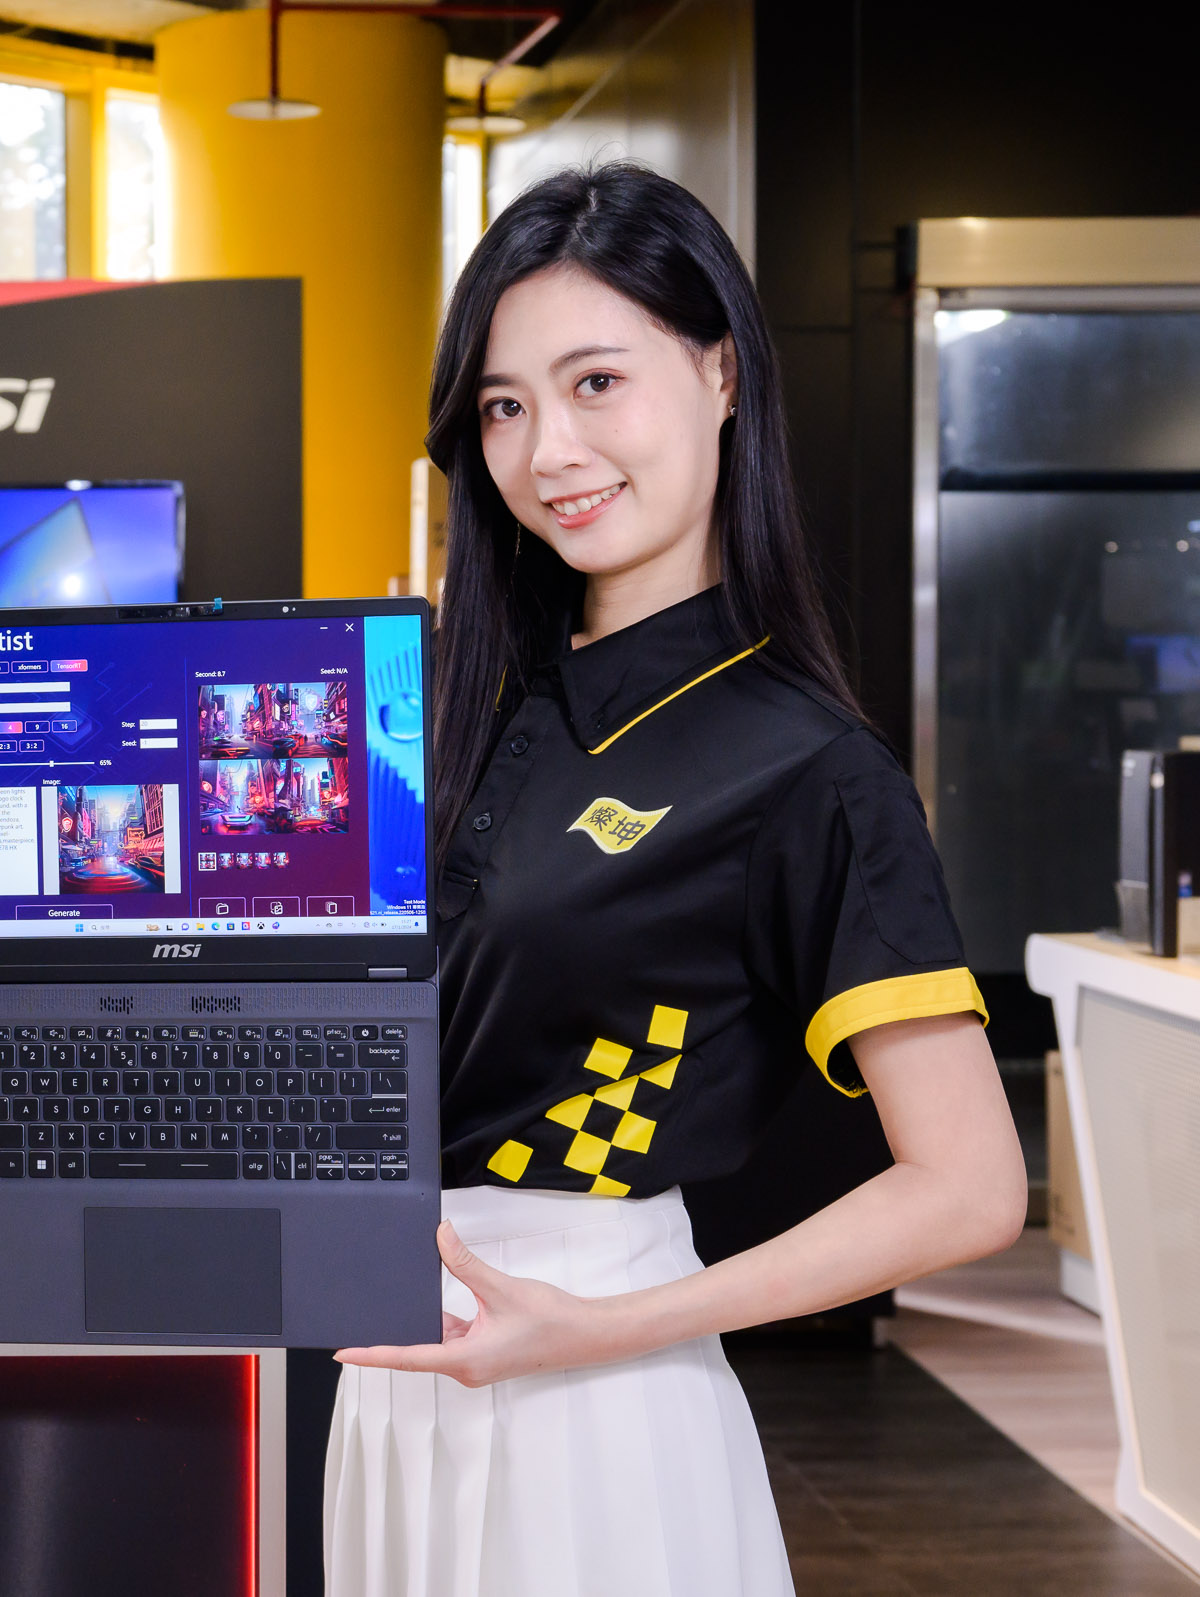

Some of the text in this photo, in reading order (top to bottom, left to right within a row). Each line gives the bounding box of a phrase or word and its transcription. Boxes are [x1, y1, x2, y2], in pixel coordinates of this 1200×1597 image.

[17, 663, 42, 671] xformers
[56, 662, 82, 670] TensorRT
[320, 667, 336, 675] Seed:
[121, 721, 136, 729] Step:
[26, 742, 38, 750] 3:2
[121, 739, 138, 747] Seed:
[42, 778, 62, 786] Image:
[583, 805, 647, 846] 燦坤
[47, 909, 81, 917] Generate
[152, 943, 202, 958] msi
[29, 1051, 36, 1060] 2
[60, 1051, 66, 1060] 3
[90, 1052, 96, 1060] 4
[120, 1051, 127, 1060] 5
[151, 1051, 158, 1060] 6
[182, 1051, 188, 1060] 7
[212, 1051, 219, 1060] 8
[243, 1051, 250, 1060] 9
[274, 1051, 281, 1060] 0
[368, 1047, 400, 1056] backspace
[10, 1078, 19, 1087] Q
[39, 1078, 50, 1086] W
[72, 1078, 78, 1087] E
[102, 1078, 109, 1087] R
[133, 1078, 140, 1087] T
[163, 1078, 170, 1087] Y
[194, 1078, 201, 1087] U
[255, 1078, 264, 1087] O
[287, 1078, 294, 1087] P
[22, 1105, 30, 1114] A
[53, 1105, 59, 1114] S
[83, 1105, 90, 1114] D
[114, 1105, 120, 1114] F
[143, 1105, 152, 1114] G
[174, 1105, 182, 1114] H
[206, 1105, 212, 1114] J
[236, 1105, 243, 1114] K
[268, 1105, 274, 1115] L
[38, 1131, 45, 1141] Z
[68, 1132, 75, 1141] X
[98, 1132, 105, 1141] C
[129, 1132, 136, 1141] V
[160, 1132, 166, 1141] B
[190, 1132, 197, 1141] N
[221, 1132, 229, 1141] M
[318, 1153, 333, 1162] pgup
[382, 1153, 397, 1162] pgdn
